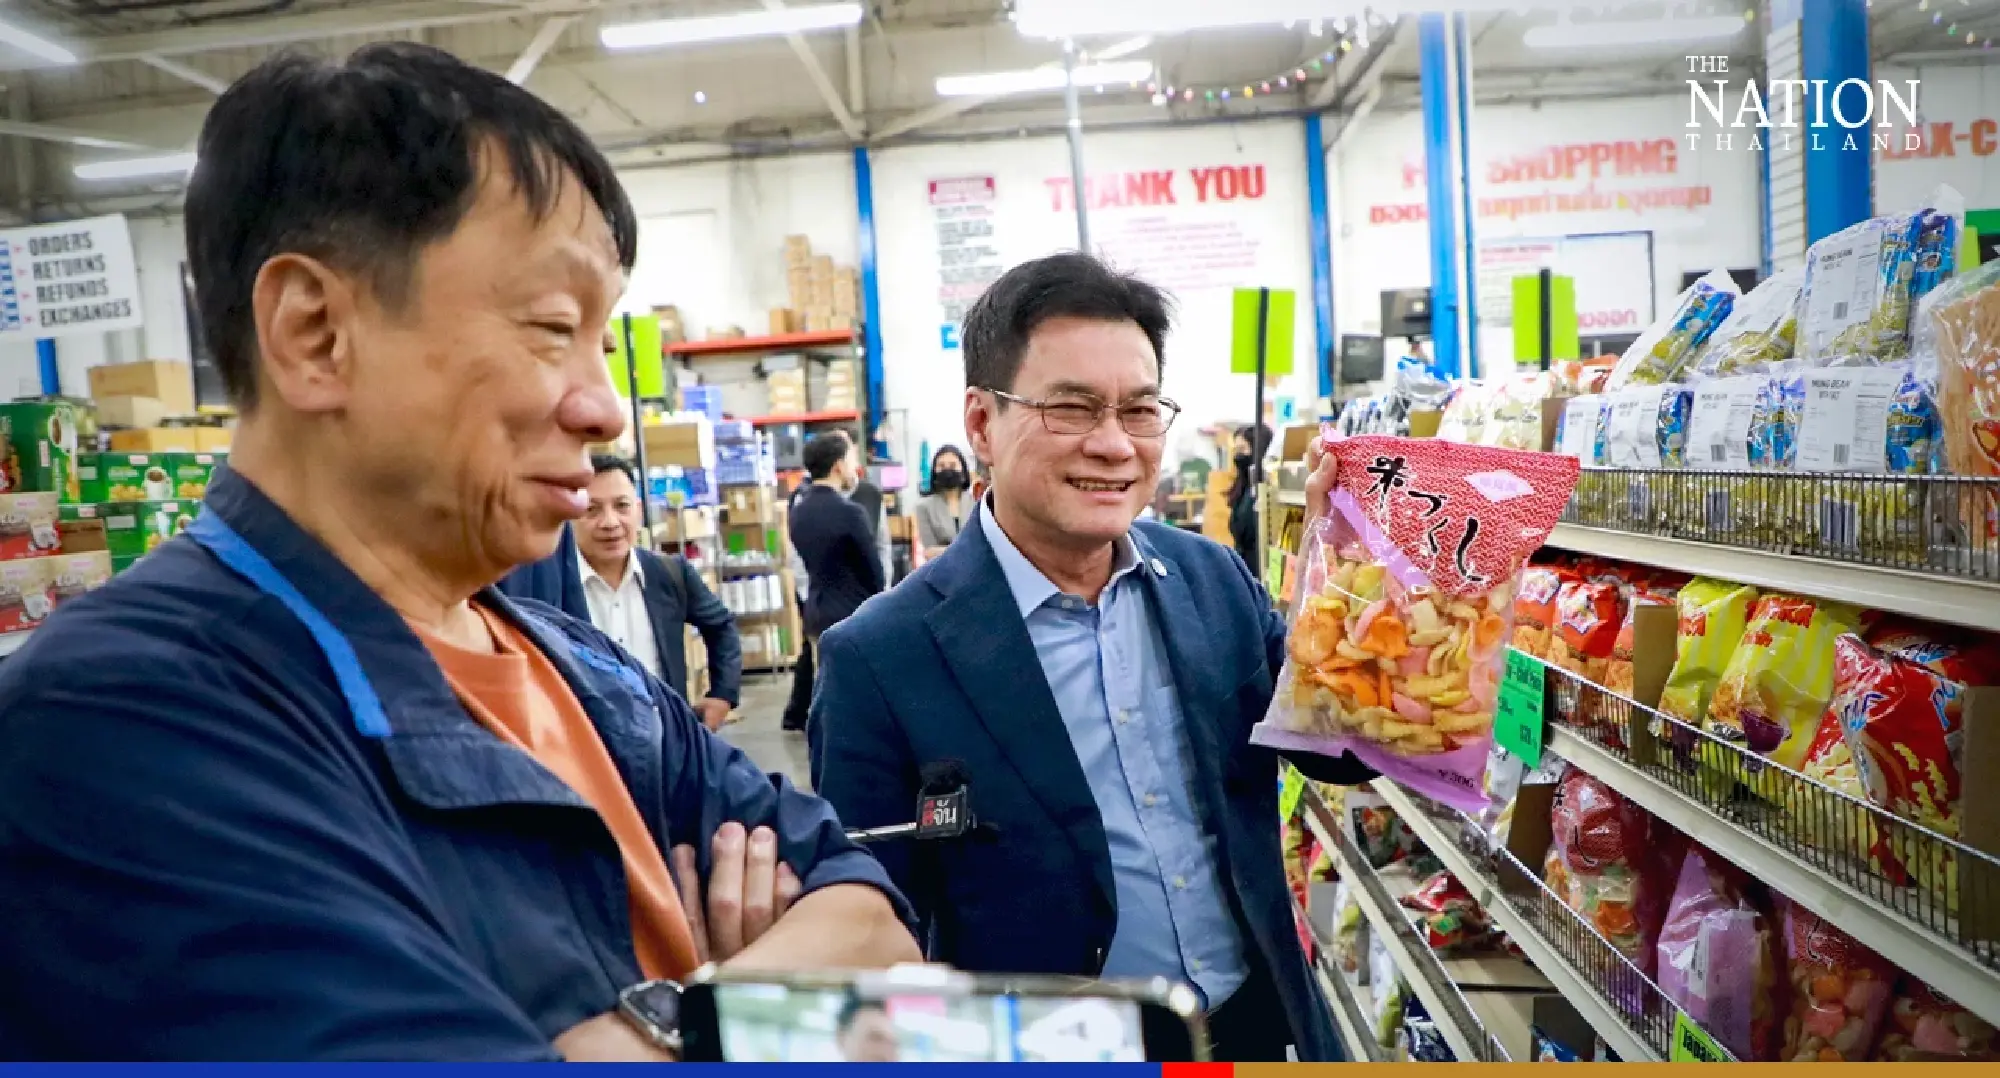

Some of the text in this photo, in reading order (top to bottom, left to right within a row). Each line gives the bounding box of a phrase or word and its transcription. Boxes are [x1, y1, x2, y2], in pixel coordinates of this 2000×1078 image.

[1188, 163, 1266, 203] YOU
[28, 231, 93, 257] ORDERS
[32, 254, 106, 281] RETURNS
[36, 278, 109, 304] REFUNDS
[40, 298, 132, 328] EXCHANGES
